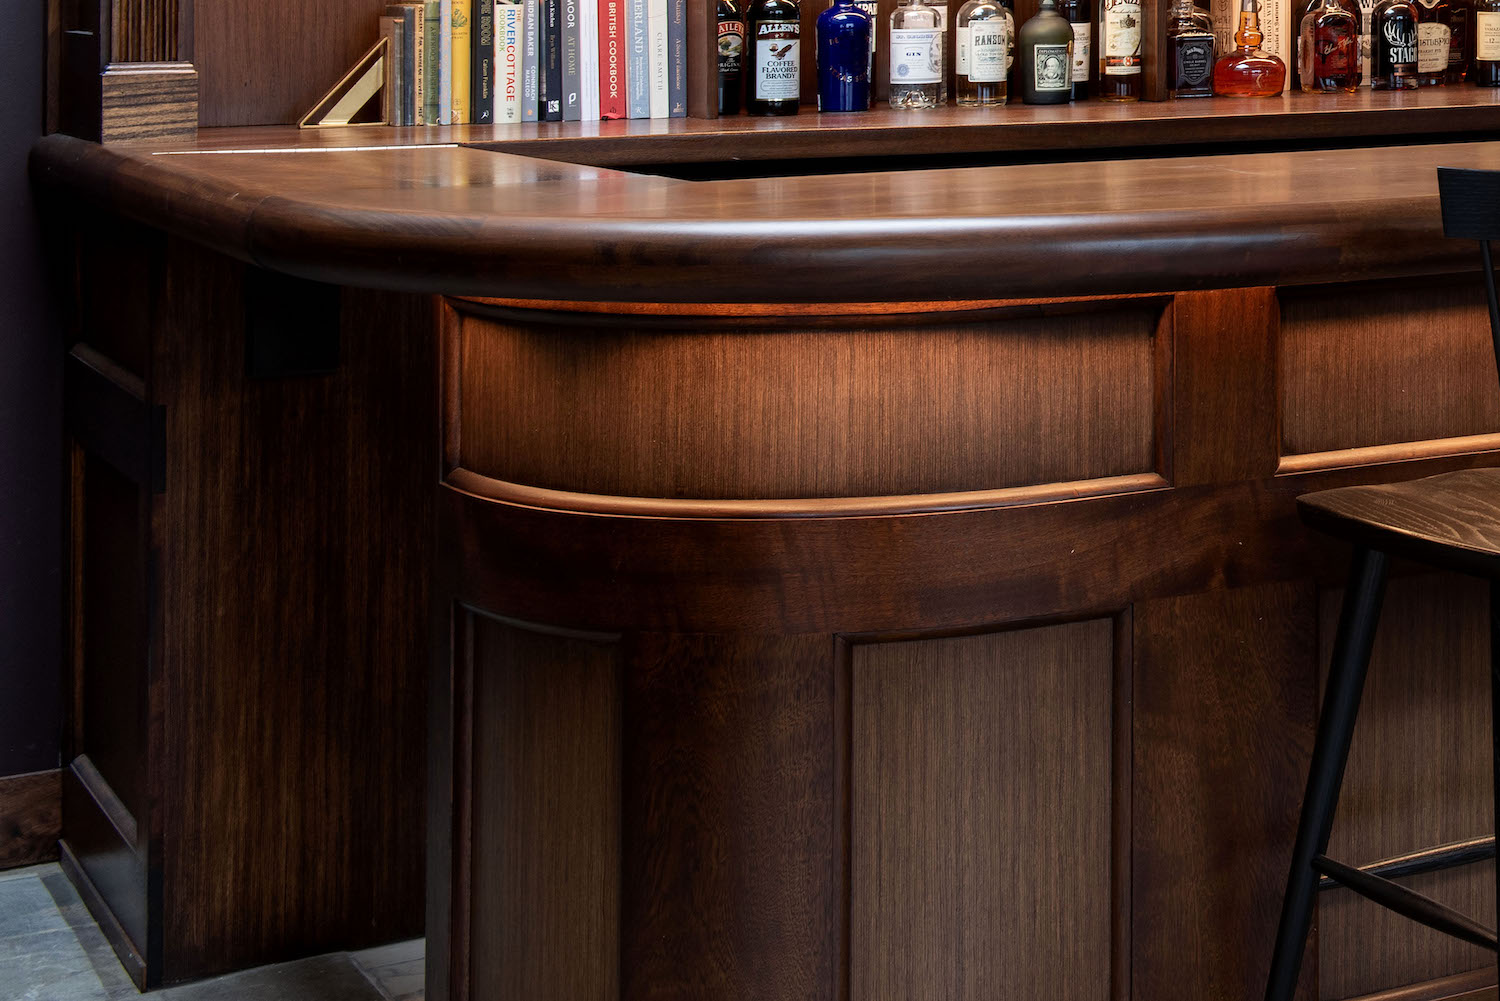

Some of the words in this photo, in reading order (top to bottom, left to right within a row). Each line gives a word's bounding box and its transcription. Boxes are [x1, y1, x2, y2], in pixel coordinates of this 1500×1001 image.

[480, 16, 491, 46] ROOM
[608, 2, 617, 38] BRITISH
[758, 23, 800, 35] ALLEN'S
[429, 26, 437, 62] COOKERY
[527, 32, 535, 57] BAKER
[567, 36, 576, 48] AT
[974, 34, 1006, 46] RANSOM
[568, 49, 577, 76] HOME
[609, 40, 618, 98] COOKBOOK
[1125, 56, 1132, 67] 8
